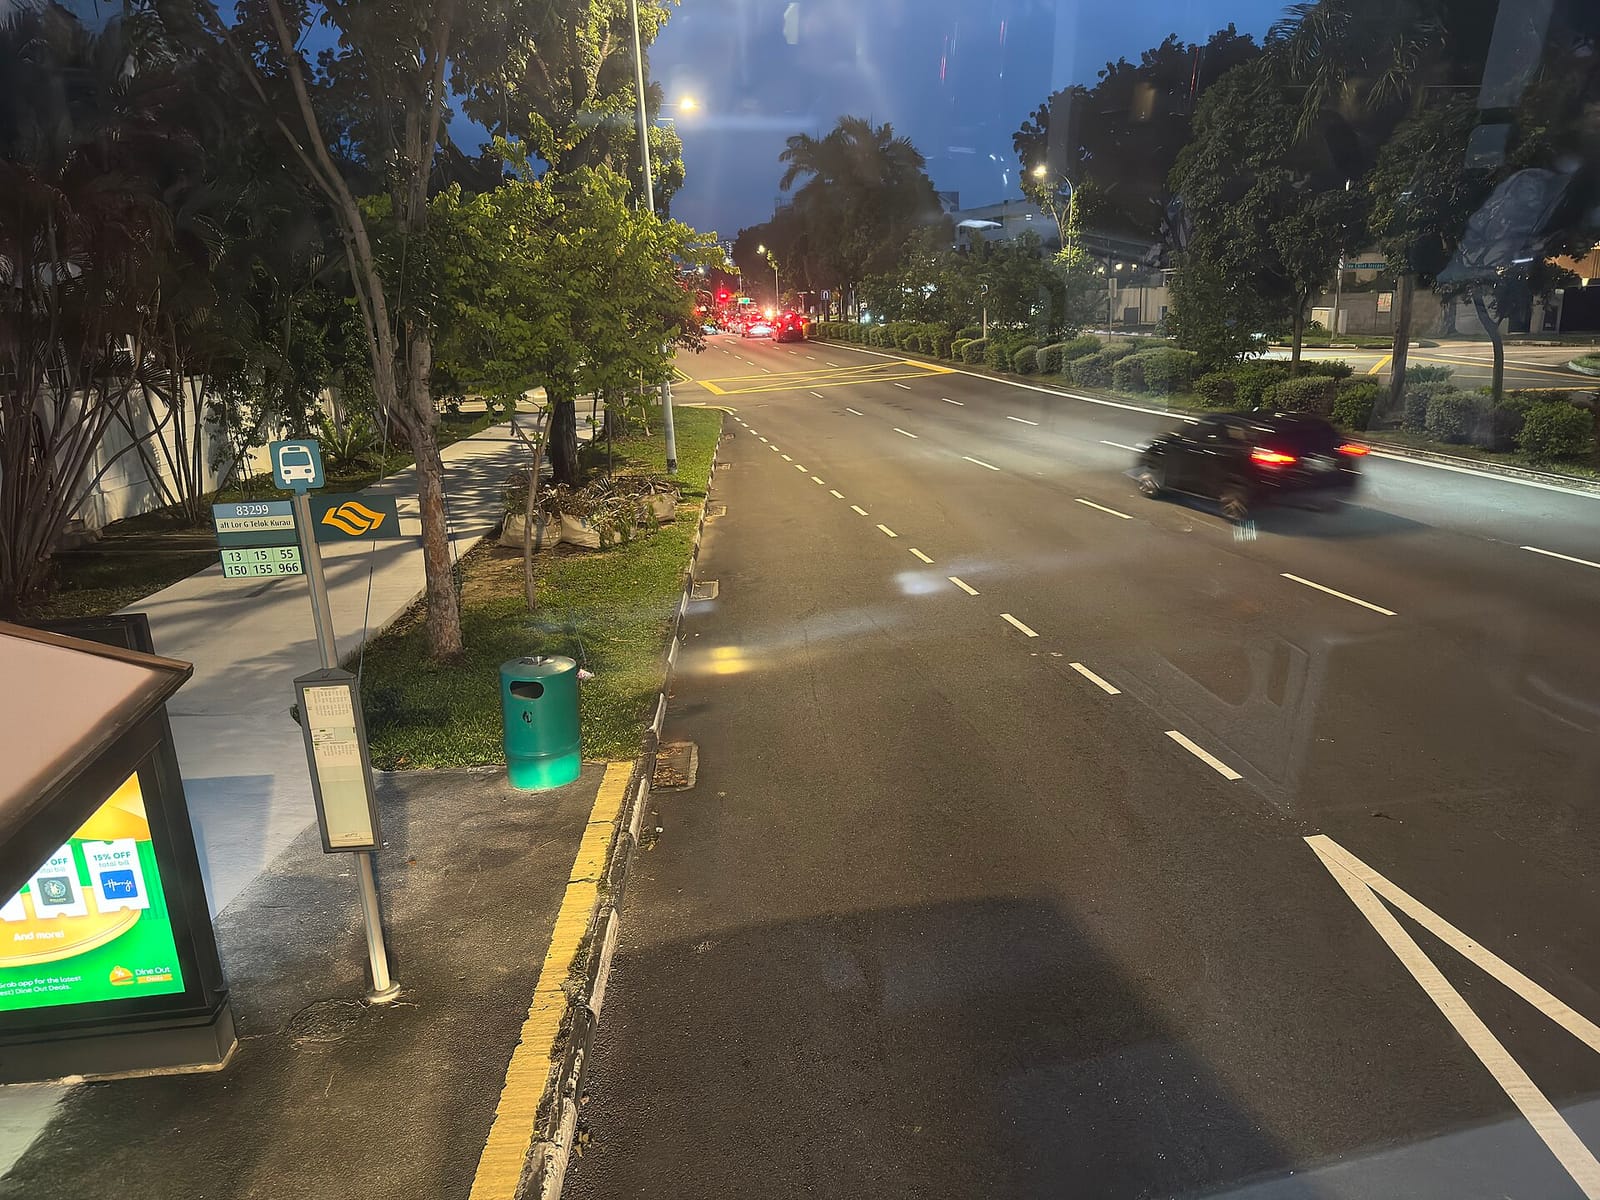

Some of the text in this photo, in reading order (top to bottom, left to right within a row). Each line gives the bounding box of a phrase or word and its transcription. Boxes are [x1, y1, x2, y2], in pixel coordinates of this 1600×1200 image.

[236, 504, 269, 516] 83299
[270, 519, 291, 527] Kurau
[228, 549, 294, 562] 13 15 55
[228, 562, 299, 576] 150 155 966
[93, 851, 131, 861] 15% OFF
[50, 858, 68, 866] OFF
[14, 931, 34, 941] And
[135, 966, 171, 976] Dine Out
[34, 977, 46, 985] for
